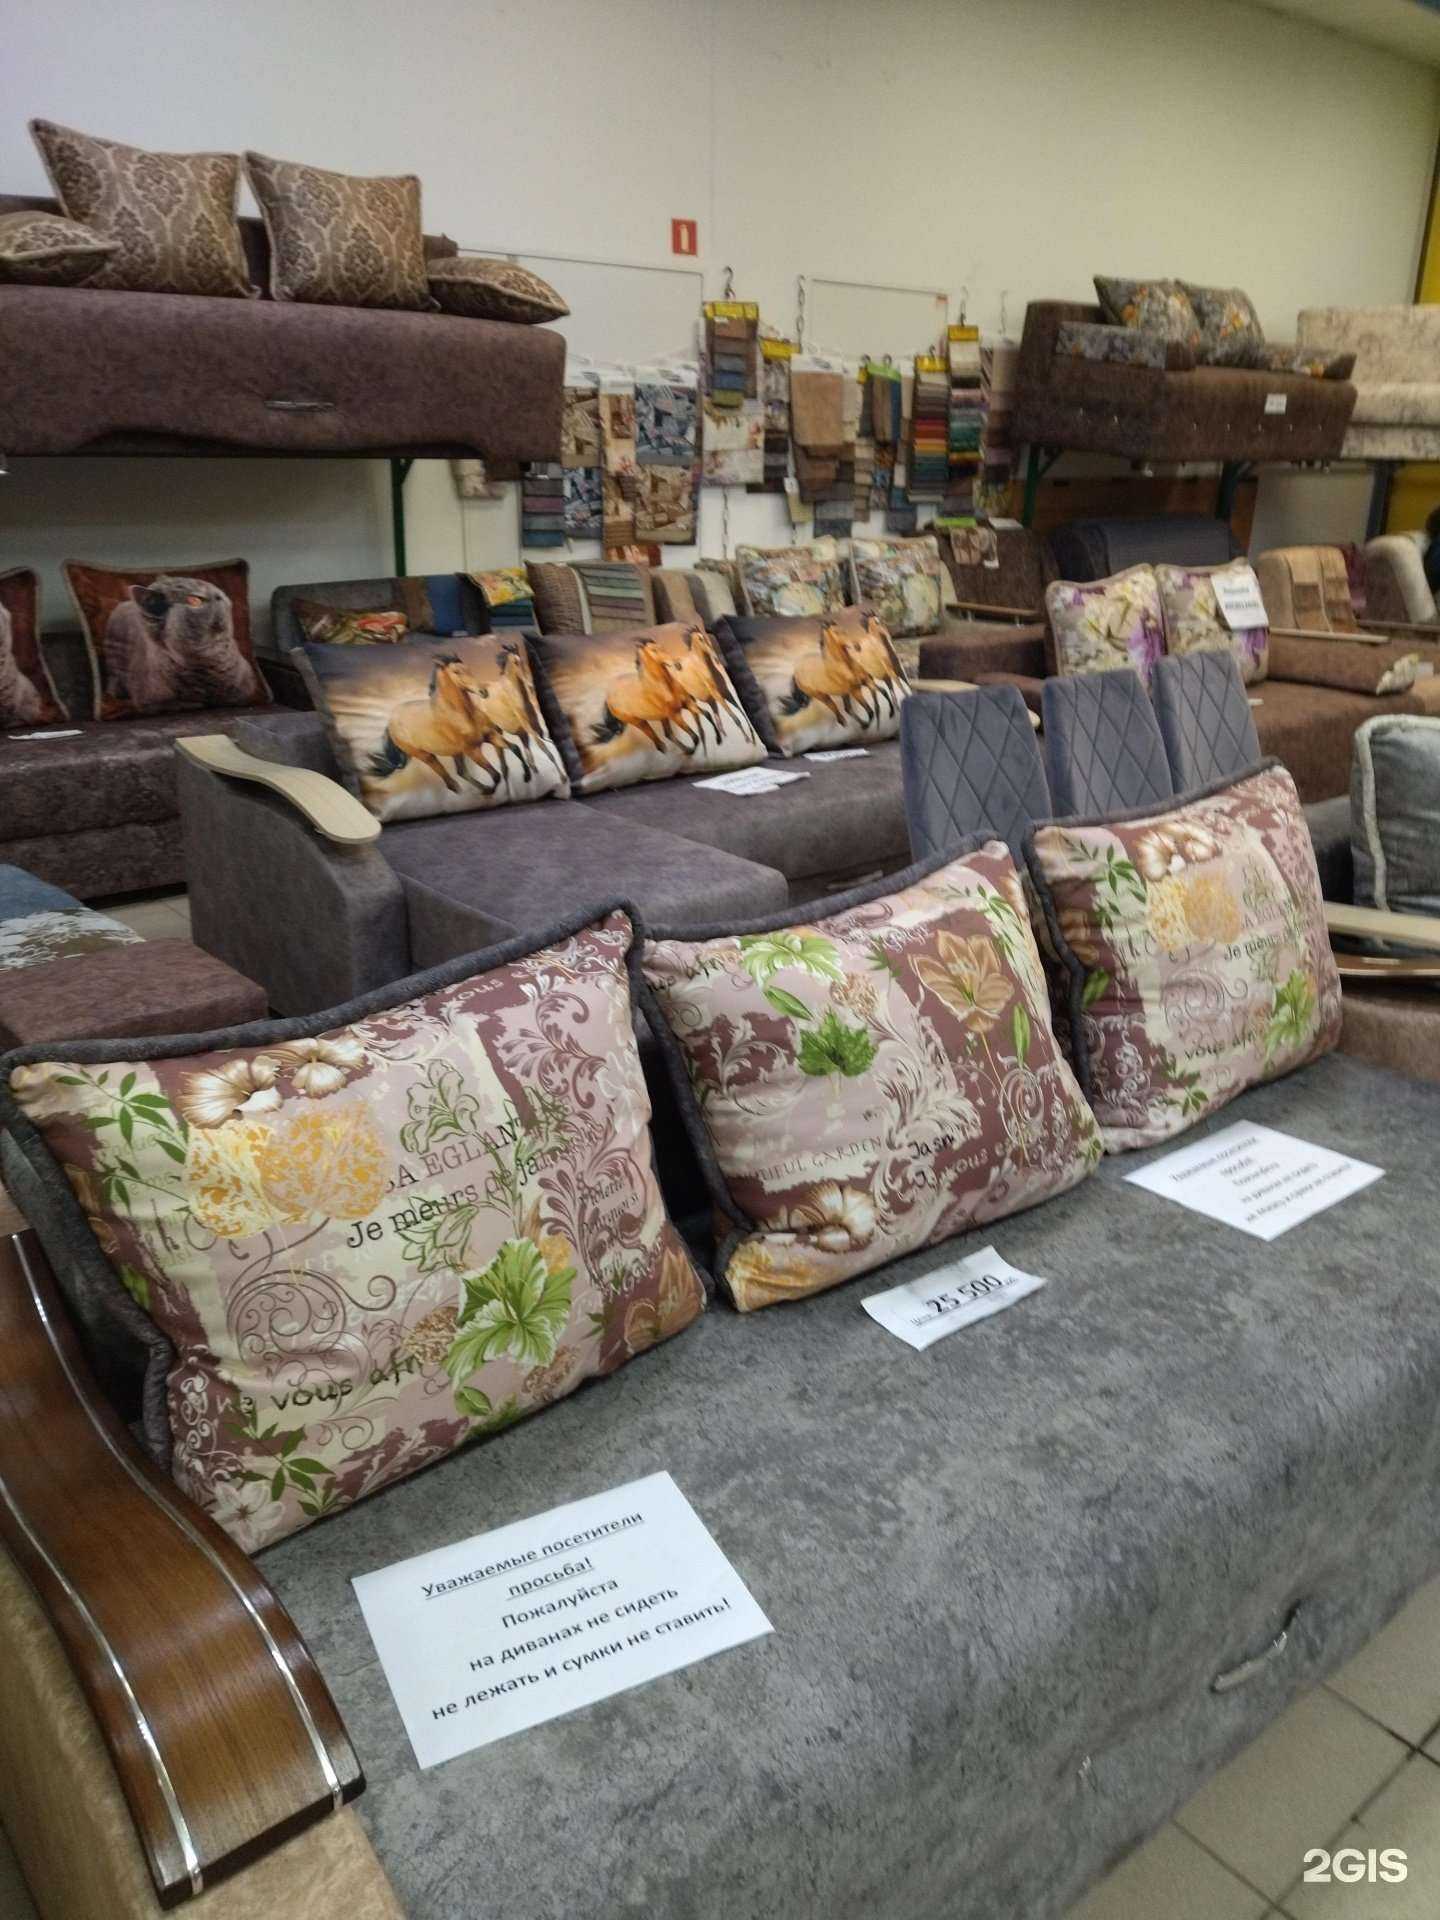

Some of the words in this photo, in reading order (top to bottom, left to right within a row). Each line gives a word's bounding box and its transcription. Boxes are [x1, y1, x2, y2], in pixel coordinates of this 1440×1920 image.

[346, 1220, 384, 1249] Je
[957, 1274, 1002, 1300] 500
[270, 1378, 353, 1411] vous
[421, 1547, 538, 1598] Уважаемые
[541, 1511, 644, 1558] посетители
[507, 1557, 594, 1598] просьба!
[501, 1578, 620, 1629] Пожалуйста
[469, 1653, 495, 1672] на
[500, 1624, 583, 1665] диванах
[587, 1611, 611, 1631] не
[614, 1586, 679, 1622] сидеть
[431, 1701, 458, 1720] не
[464, 1672, 539, 1708] лежать
[544, 1664, 558, 1679] и
[562, 1639, 623, 1676] сумки
[627, 1628, 652, 1648] не
[654, 1597, 732, 1636] ставить!
